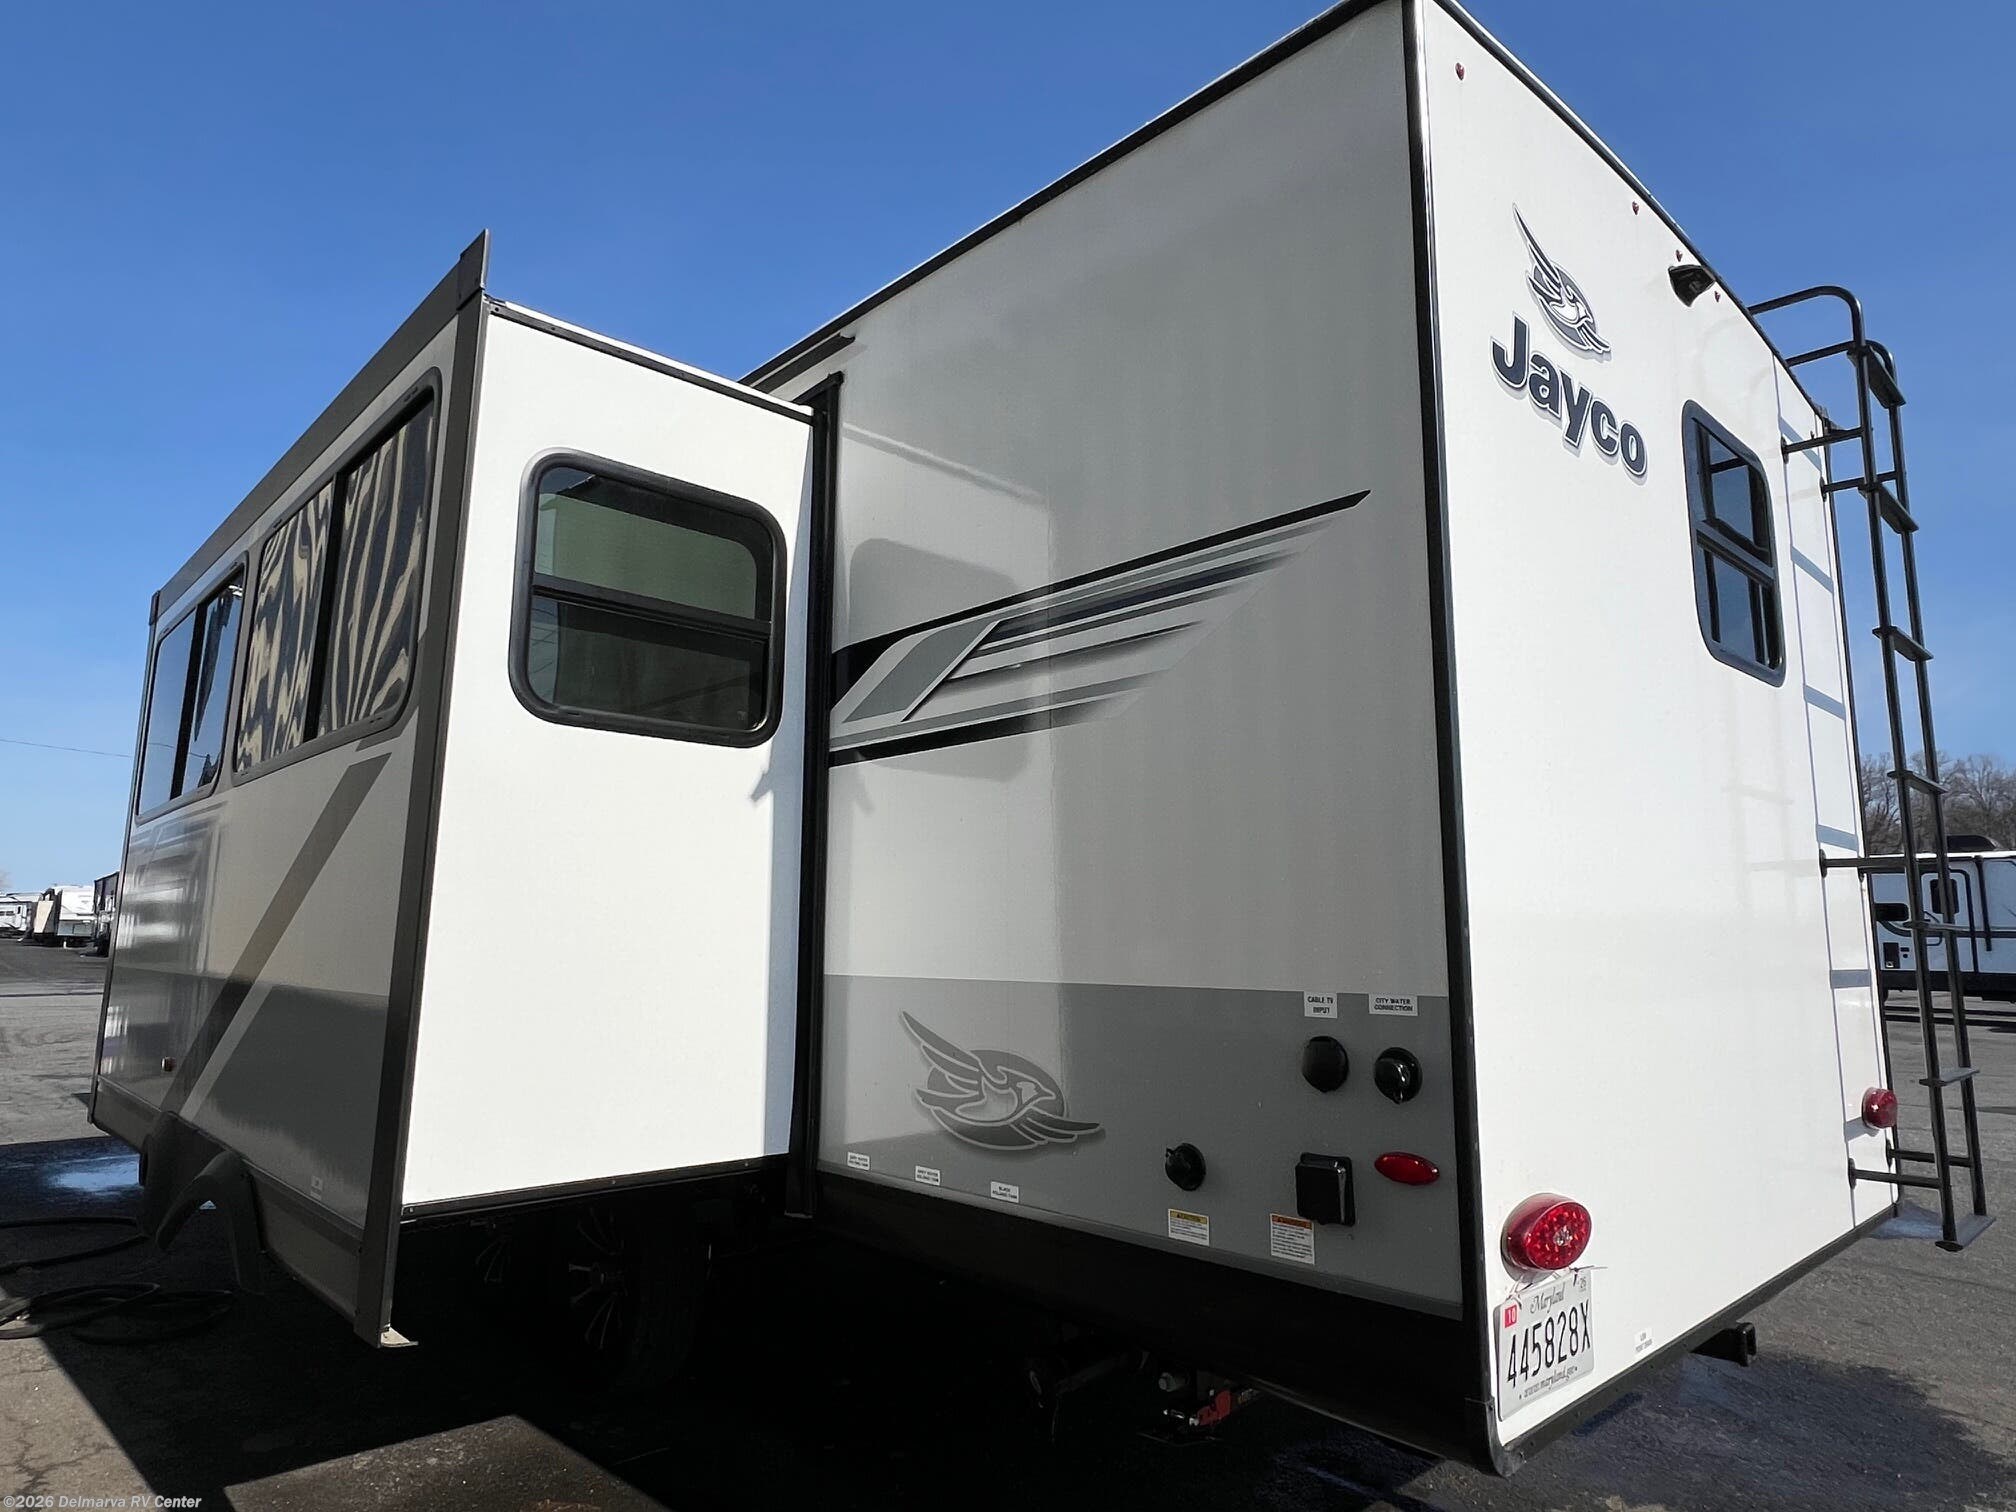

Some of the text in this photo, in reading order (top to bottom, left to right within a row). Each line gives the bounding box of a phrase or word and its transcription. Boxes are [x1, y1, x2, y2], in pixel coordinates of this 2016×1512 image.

[1491, 313, 1647, 478] Jayco
[1507, 1308, 1517, 1323] 10
[1529, 1283, 1566, 1313] Maryland
[1507, 1299, 1591, 1388] 445828X
